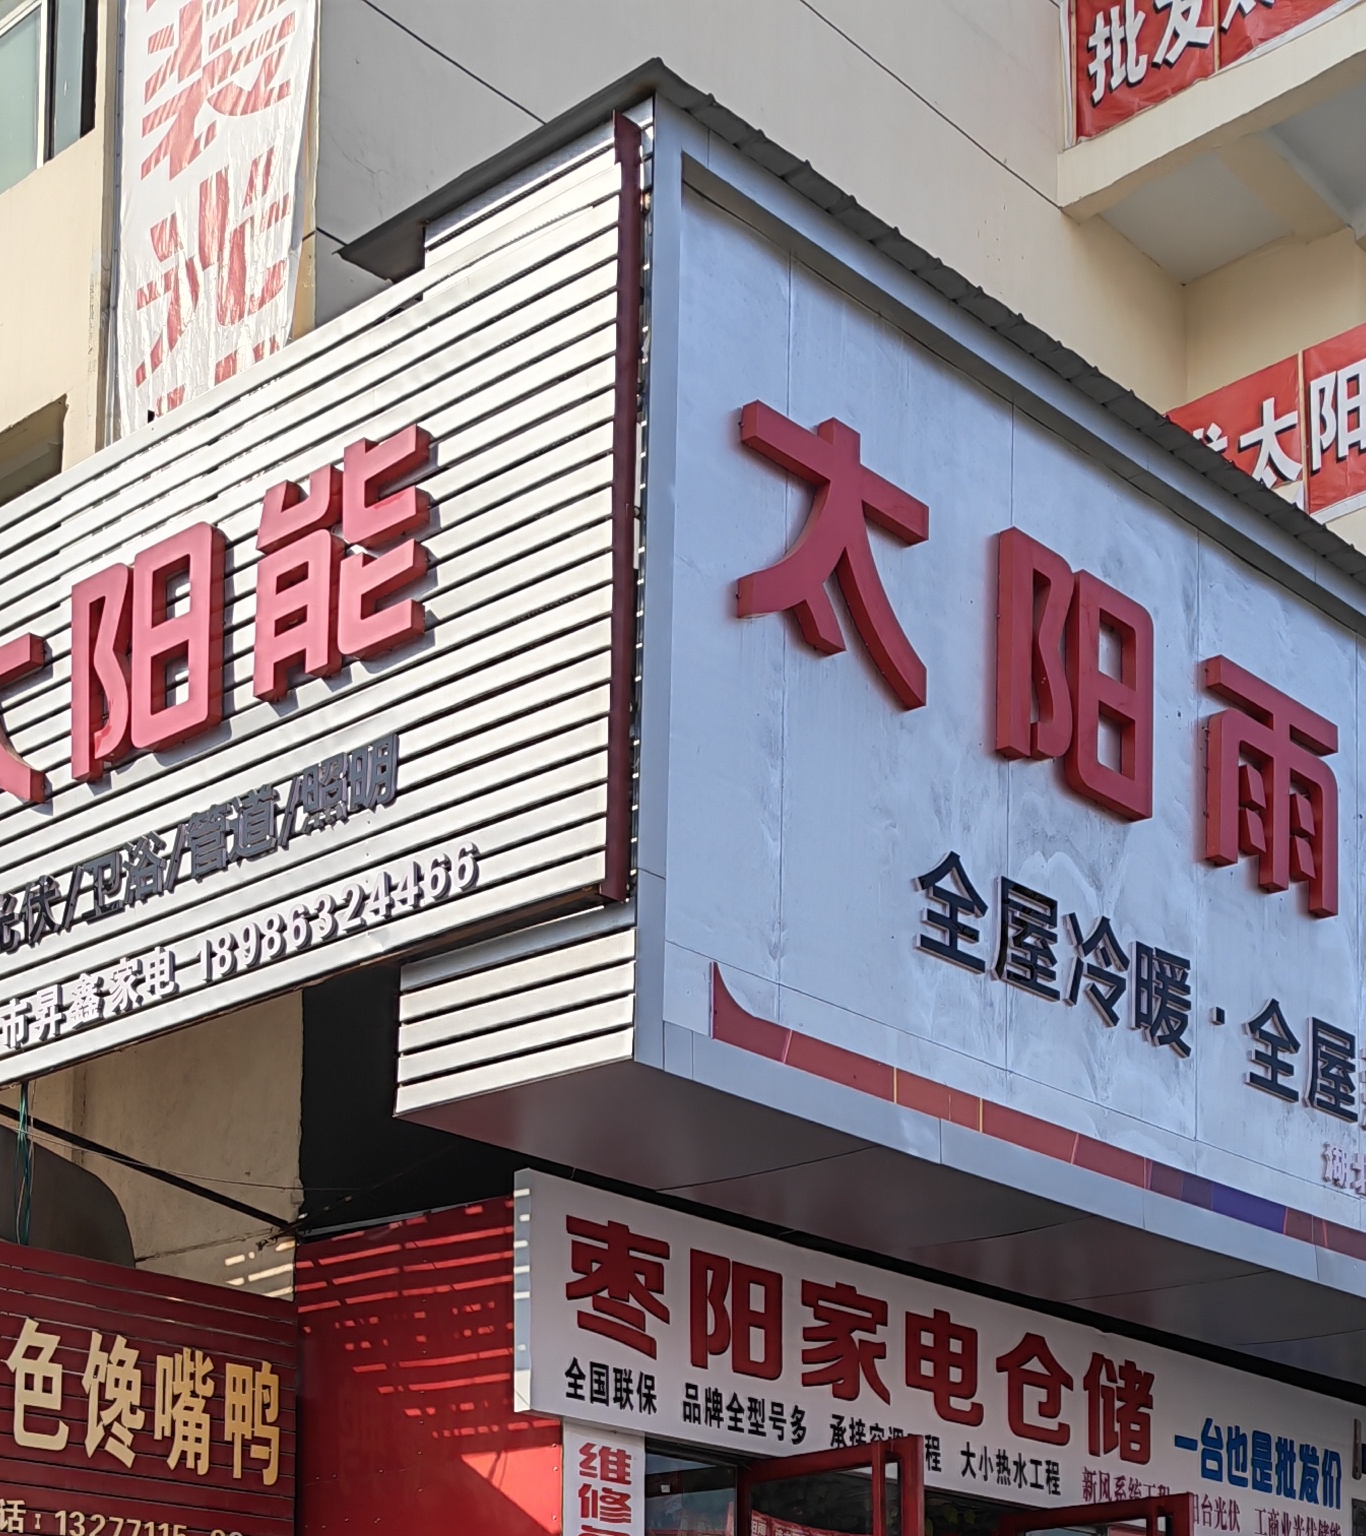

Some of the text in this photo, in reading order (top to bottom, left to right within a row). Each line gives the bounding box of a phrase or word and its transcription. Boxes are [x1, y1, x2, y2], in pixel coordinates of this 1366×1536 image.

[1087, 0, 1277, 107] 批发
[197, 842, 478, 983] 18986324466
[565, 1215, 1155, 1466] 枣阳家电仓储
[565, 1357, 1061, 1496] 全国联保 品牌全型号多 承接空程 大小热水工程
[1173, 1417, 1343, 1511] 一台也是批发价
